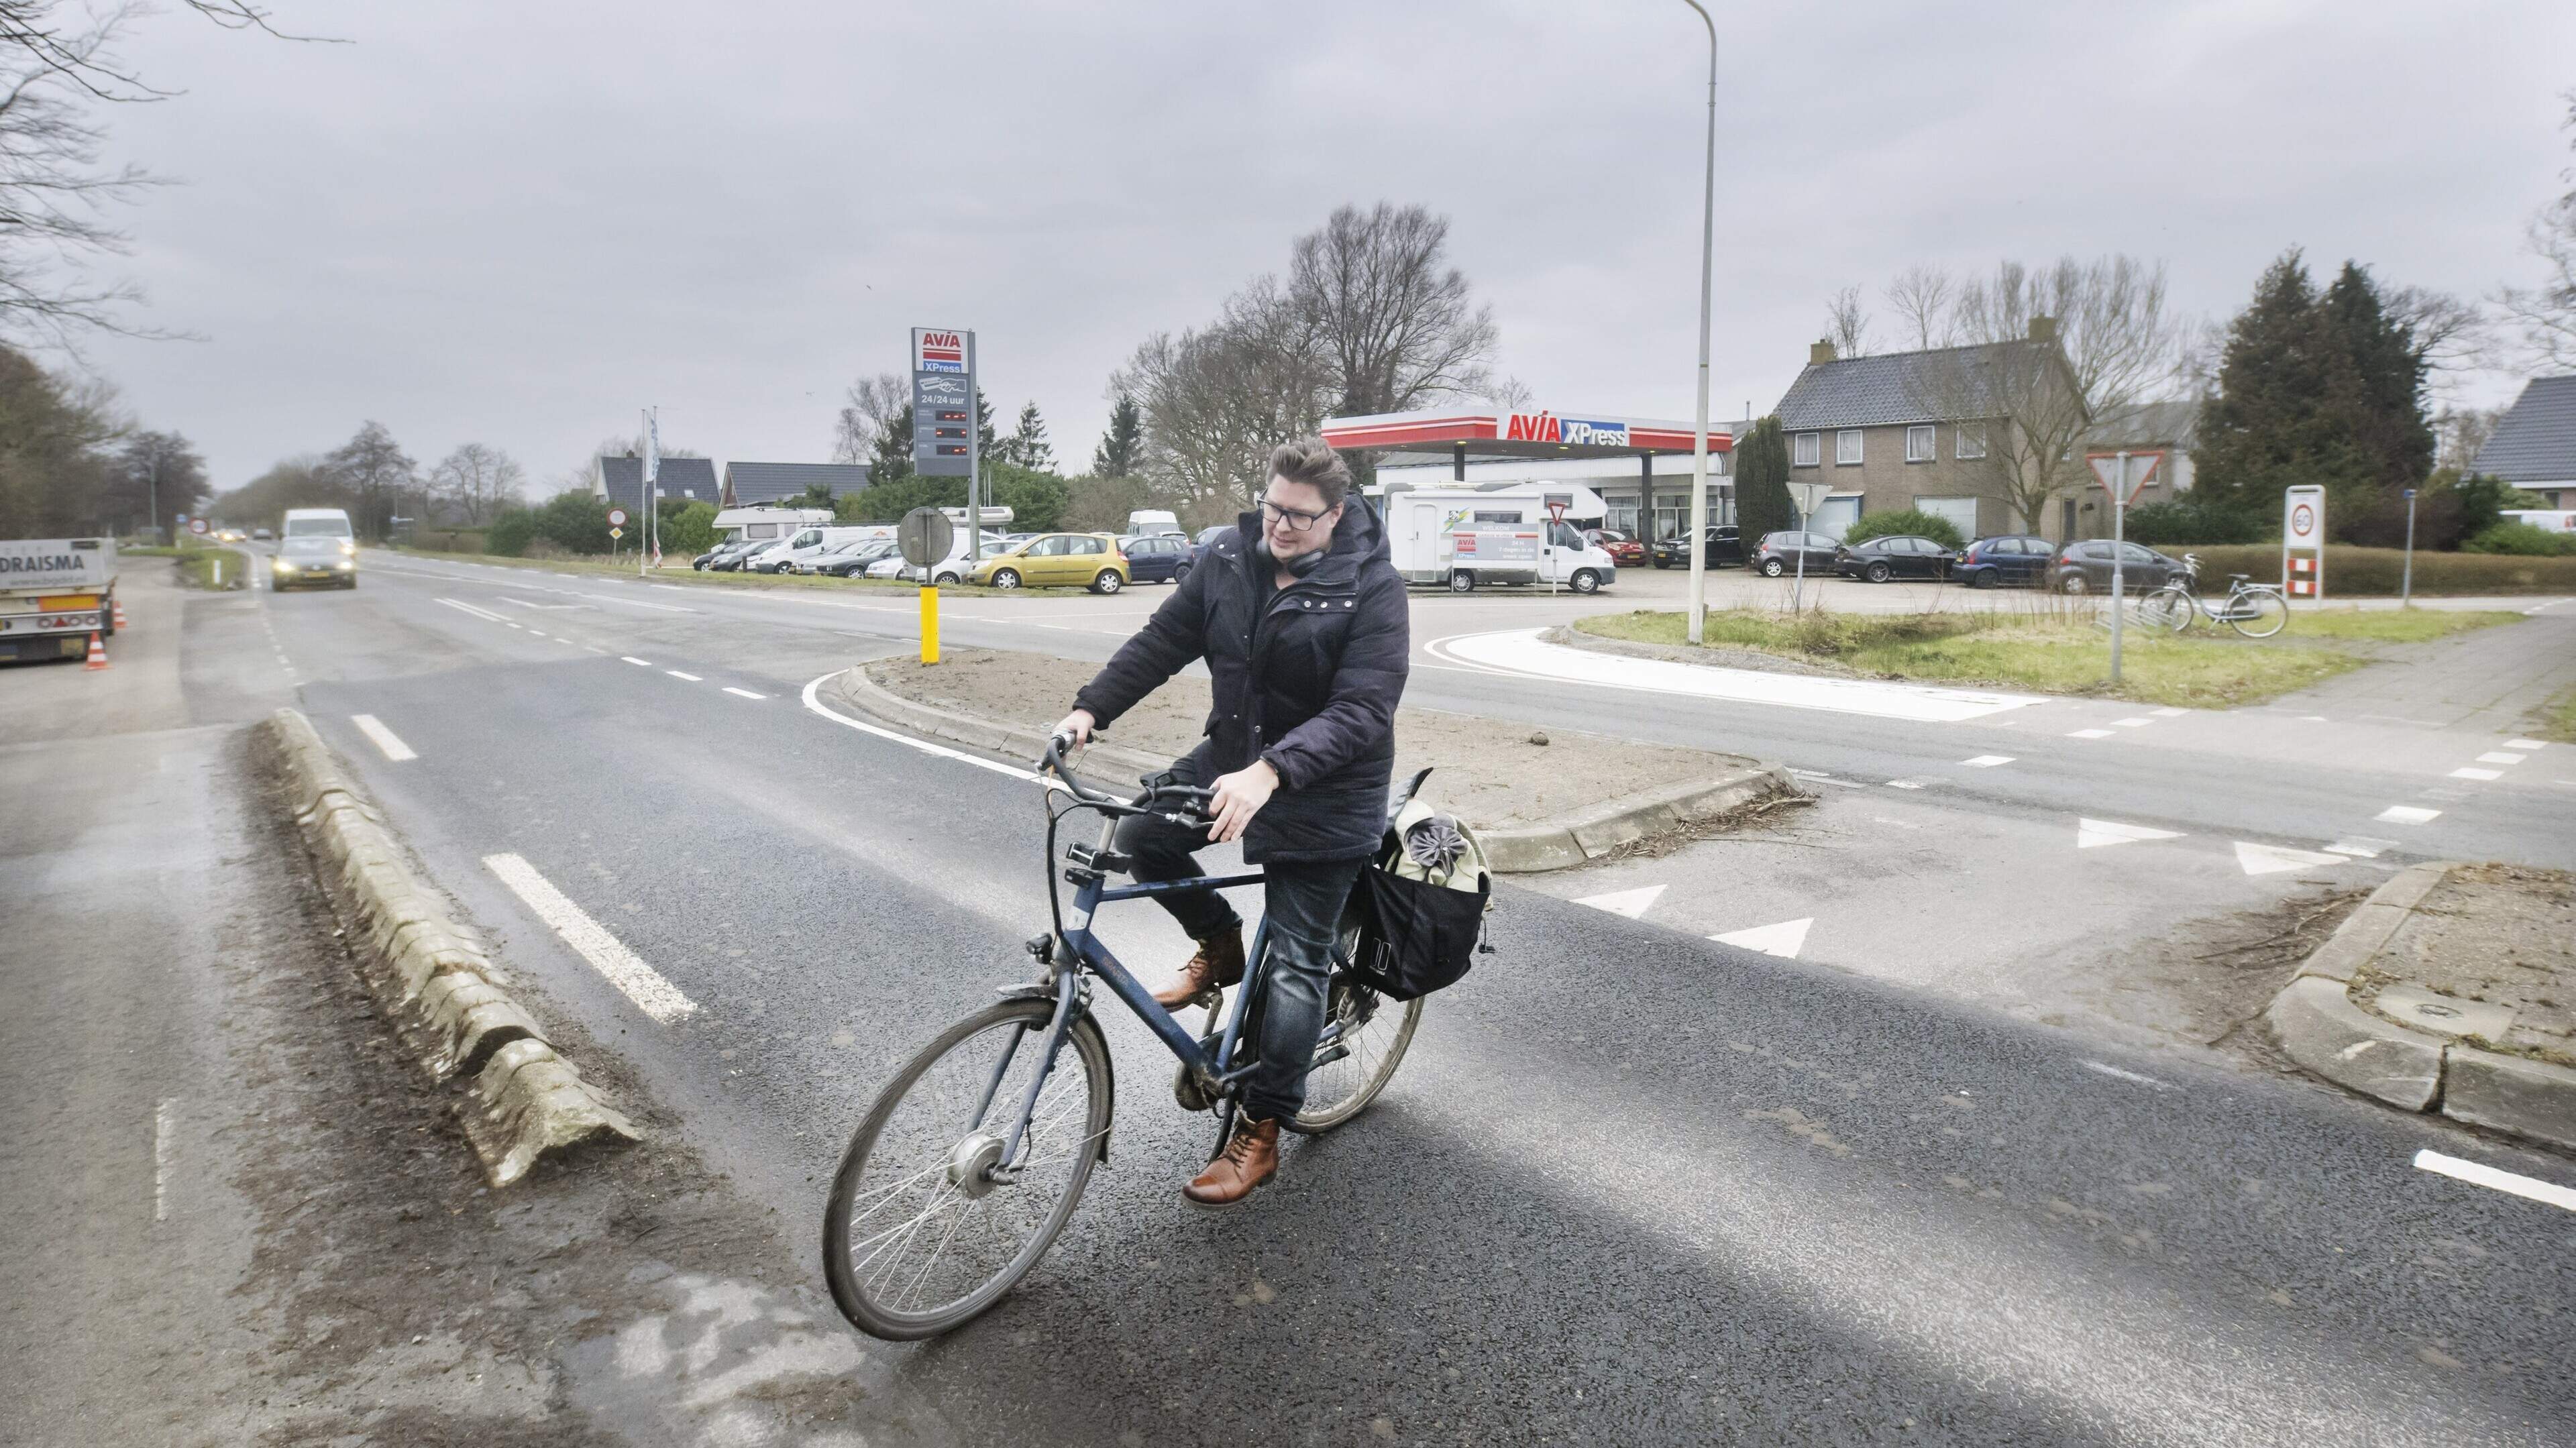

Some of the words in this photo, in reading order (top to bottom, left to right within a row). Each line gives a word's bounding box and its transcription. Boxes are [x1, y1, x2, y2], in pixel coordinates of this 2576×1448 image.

[923, 331, 961, 347] AVIA
[925, 362, 961, 374] XPress
[922, 394, 948, 404] 24/24
[1507, 410, 1562, 443] AVIA
[1563, 421, 1626, 447] XPress
[1457, 538, 1476, 546] AVIA
[0, 555, 84, 573] DRAISMA
